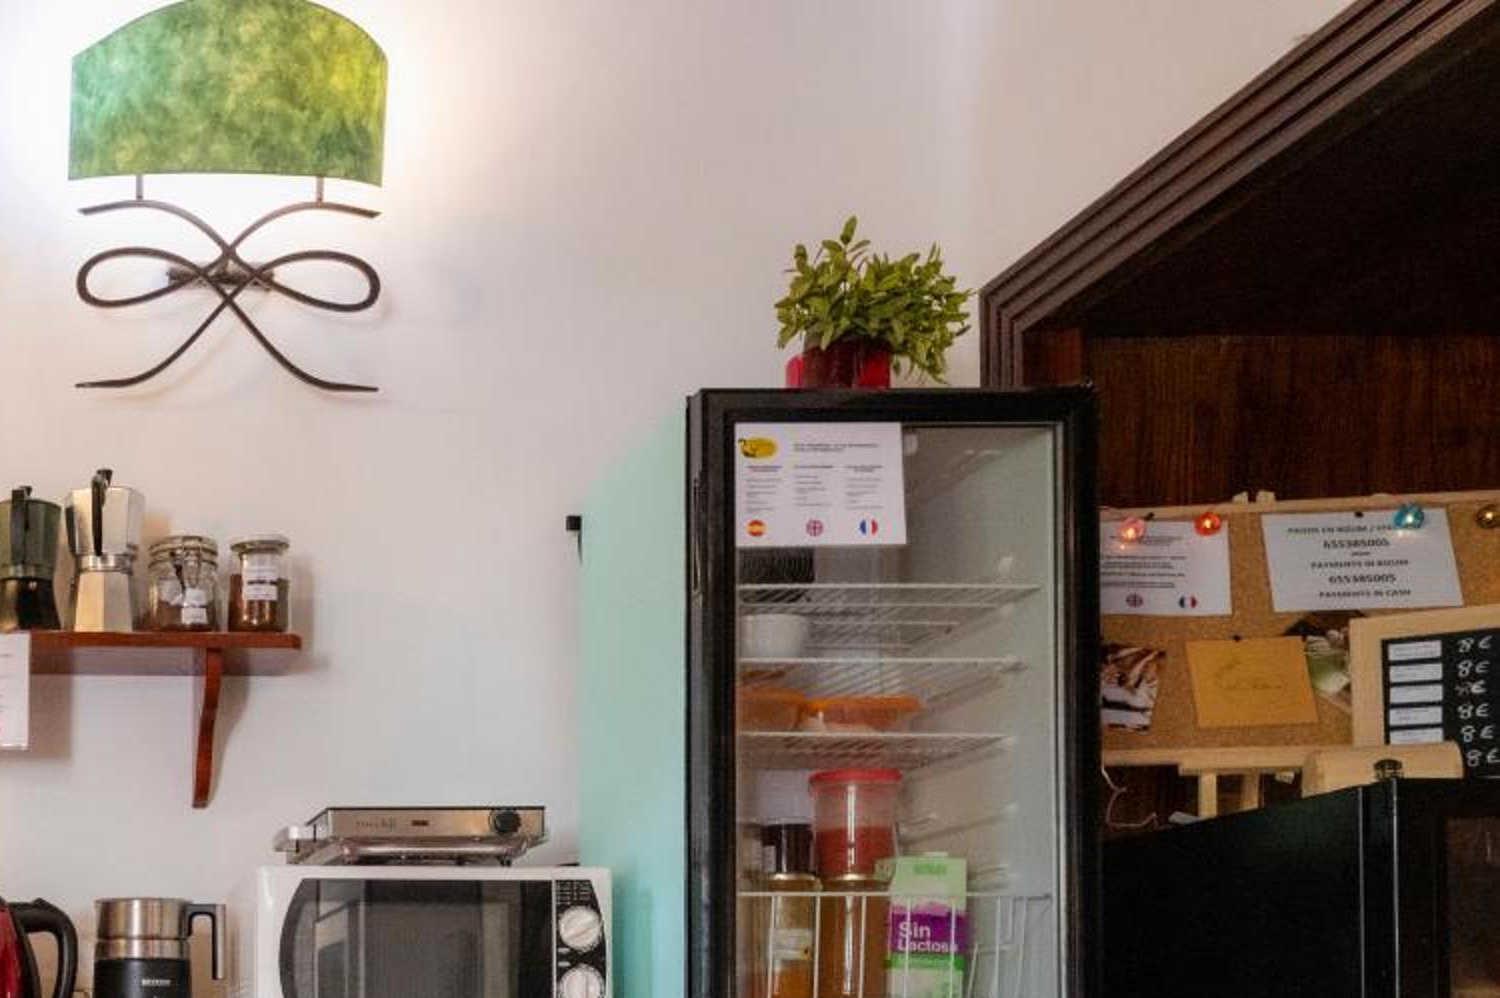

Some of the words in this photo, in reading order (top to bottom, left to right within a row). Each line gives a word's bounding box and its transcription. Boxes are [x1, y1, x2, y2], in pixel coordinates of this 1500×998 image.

[1478, 635, 1493, 649] €
[1457, 659, 1473, 678] 8
[1475, 660, 1490, 674] €
[1475, 703, 1489, 717] €
[1460, 725, 1476, 743] 8
[1480, 725, 1494, 739] €
[1466, 749, 1482, 767] 8
[898, 921, 931, 939] Sin
